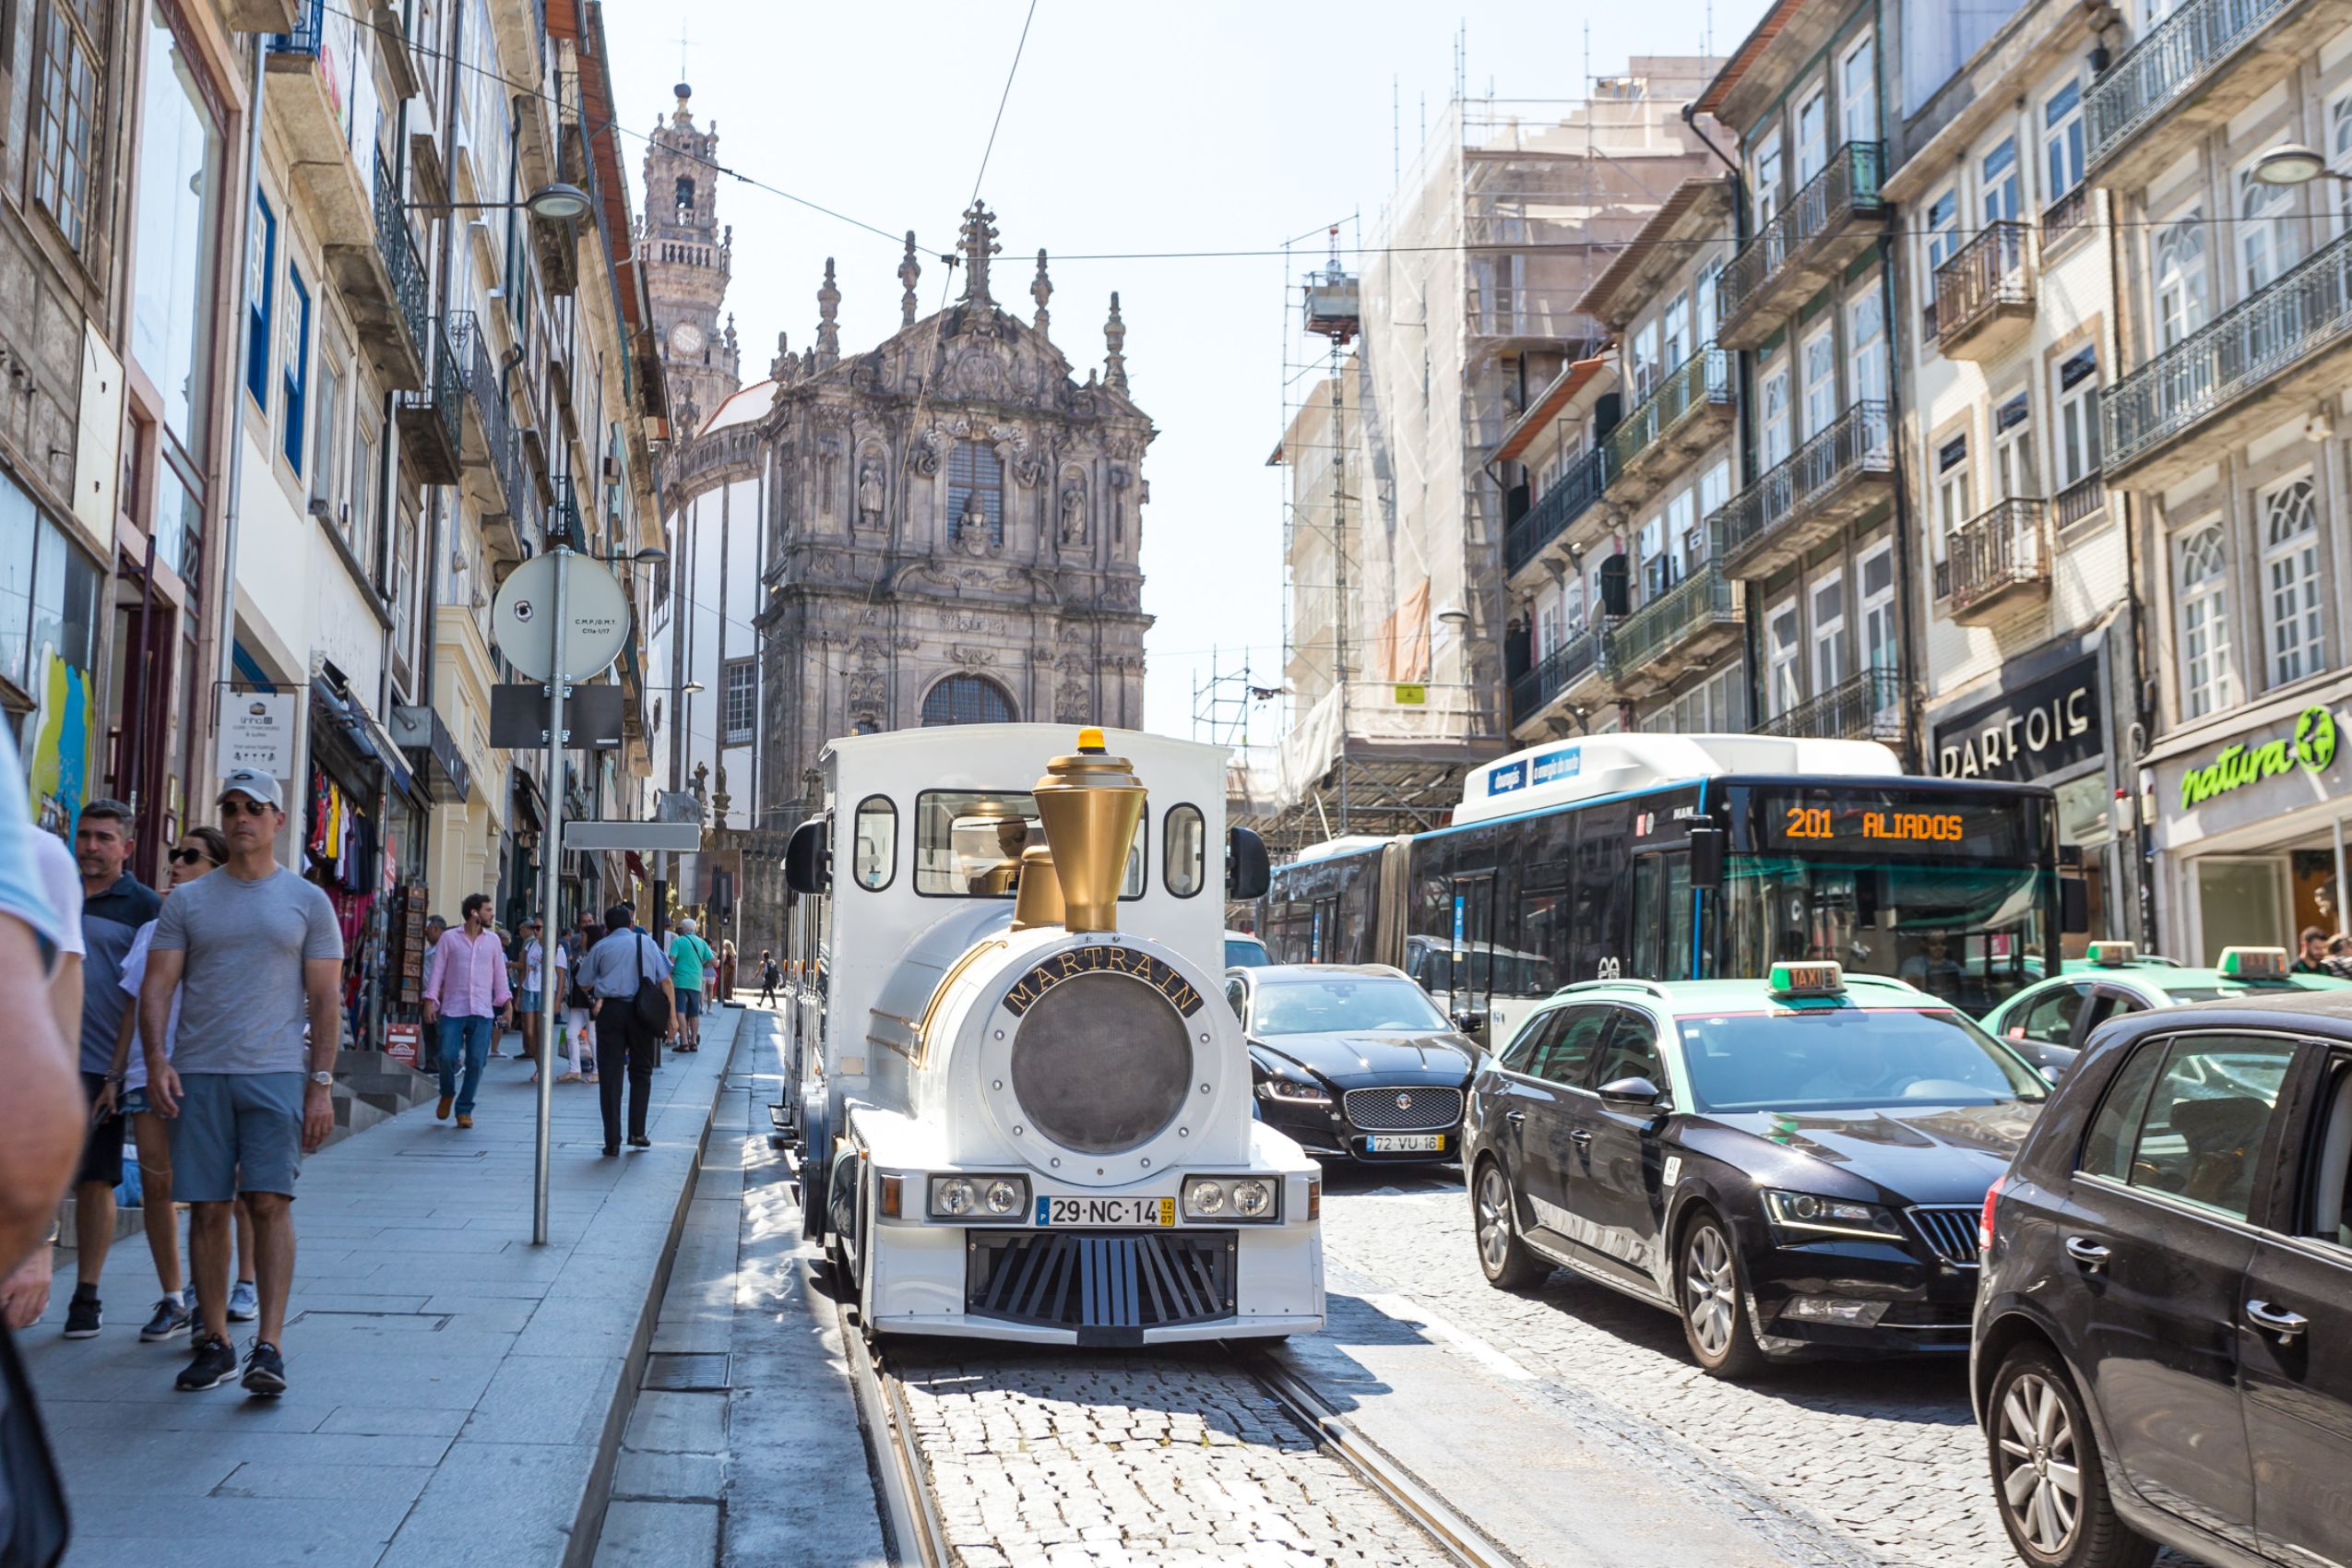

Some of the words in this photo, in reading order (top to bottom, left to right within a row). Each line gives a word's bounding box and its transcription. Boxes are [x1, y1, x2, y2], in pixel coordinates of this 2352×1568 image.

[184, 537, 200, 589] 22
[1941, 686, 2088, 779] PARFOIS
[2180, 739, 2294, 811] natura
[1786, 807, 1835, 838] 201
[1862, 812, 1963, 840] ALIADOS
[1007, 946, 1199, 1012] MARTRAIN
[1790, 968, 1823, 987] TAXI
[1161, 1201, 1173, 1210] 12
[1161, 1215, 1173, 1224] 07
